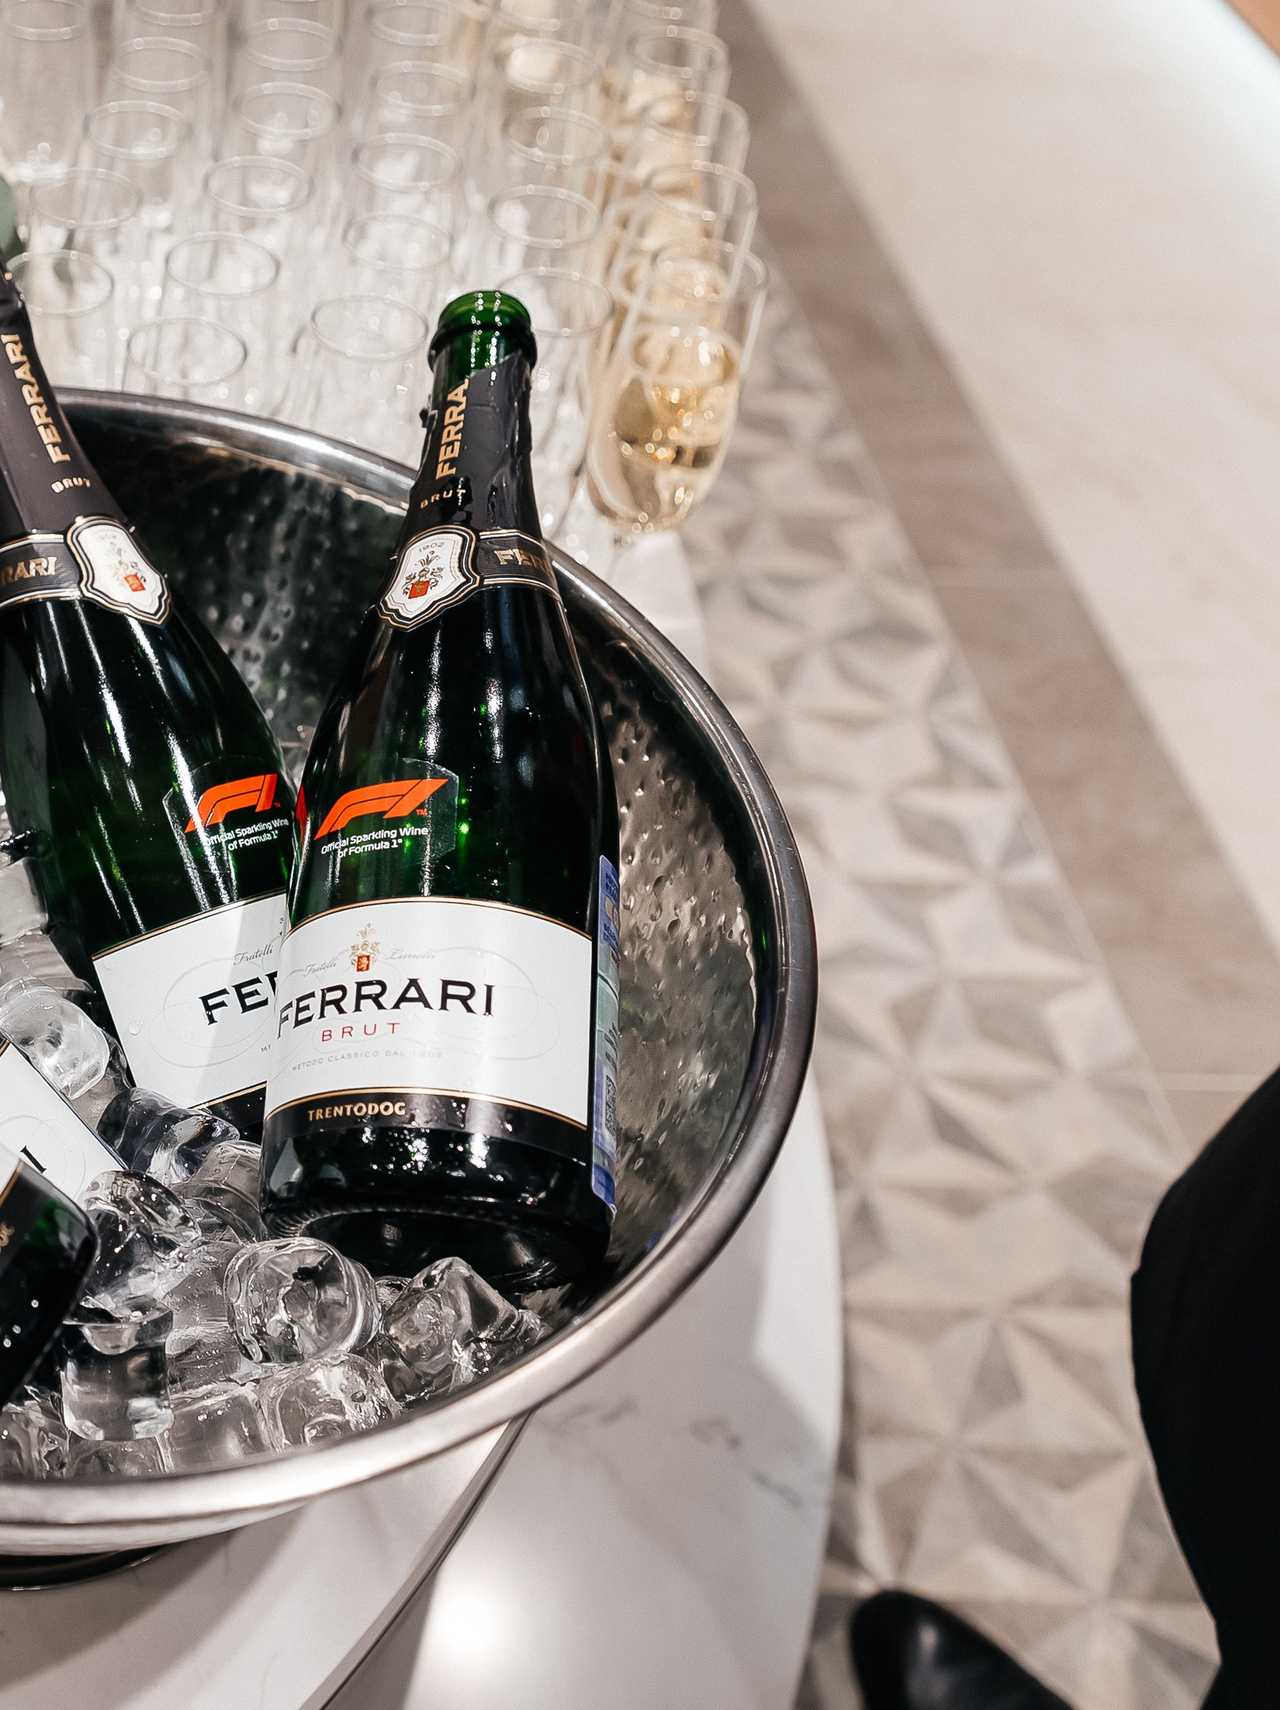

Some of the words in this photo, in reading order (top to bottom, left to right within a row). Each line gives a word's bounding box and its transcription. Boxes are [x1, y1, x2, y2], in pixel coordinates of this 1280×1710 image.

[0, 333, 71, 463] FERRARI
[435, 377, 469, 480] FERRA
[50, 476, 92, 494] BRUT
[421, 487, 466, 509] BRUT
[419, 541, 445, 553] 1902
[235, 821, 272, 838] Sparkling
[269, 817, 289, 829] Wine
[227, 839, 239, 851] of
[238, 832, 273, 848] Formula
[321, 837, 349, 855] Official
[350, 829, 397, 845] Sparkling
[399, 827, 429, 837] Wine
[338, 848, 349, 859] of
[348, 840, 390, 856] Formula
[233, 943, 274, 966] Fratelli
[277, 978, 496, 1040] FERRARI
[321, 1022, 400, 1042] BRUT
[327, 1050, 380, 1063] CLASSICO
[308, 1101, 406, 1121] TRENTODOC
